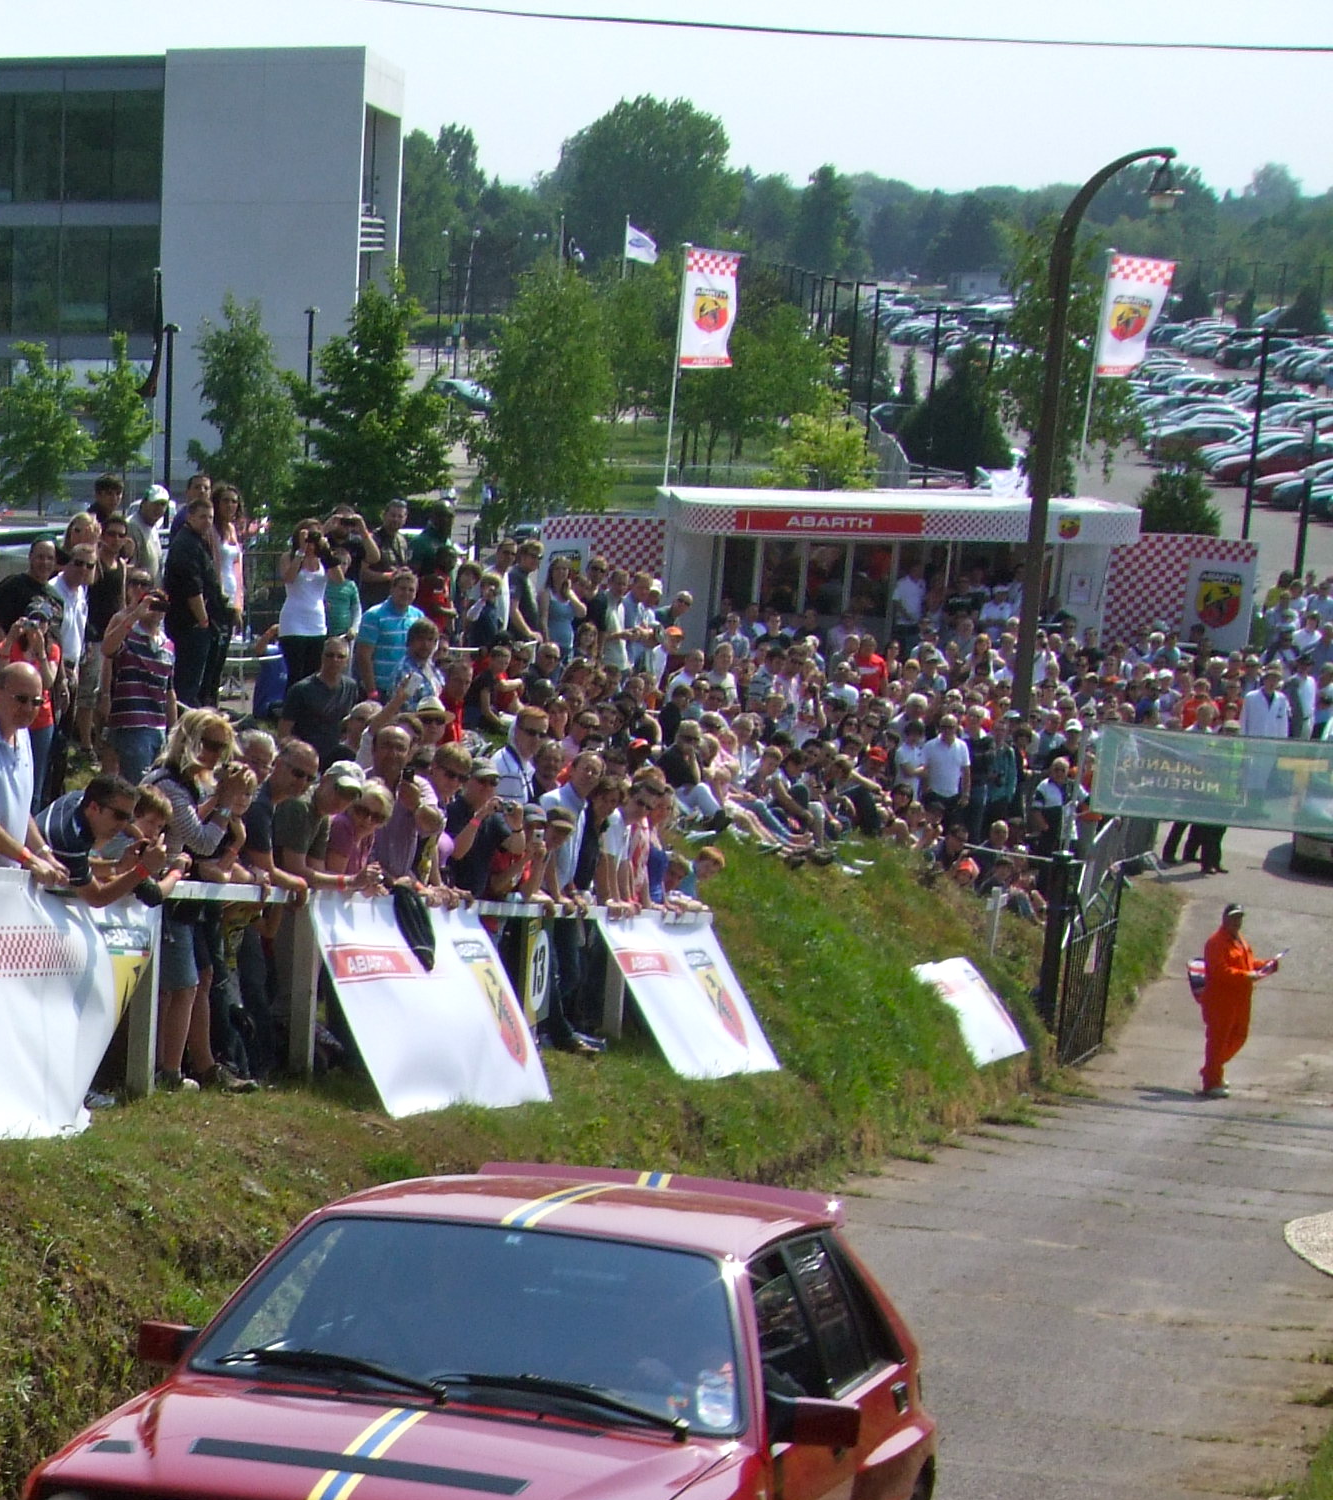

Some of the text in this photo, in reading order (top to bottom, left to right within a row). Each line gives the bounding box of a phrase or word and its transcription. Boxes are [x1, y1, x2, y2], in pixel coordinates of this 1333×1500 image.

[786, 515, 873, 529] ABARTH
[347, 955, 396, 974] ABARTH
[532, 945, 546, 997] 13
